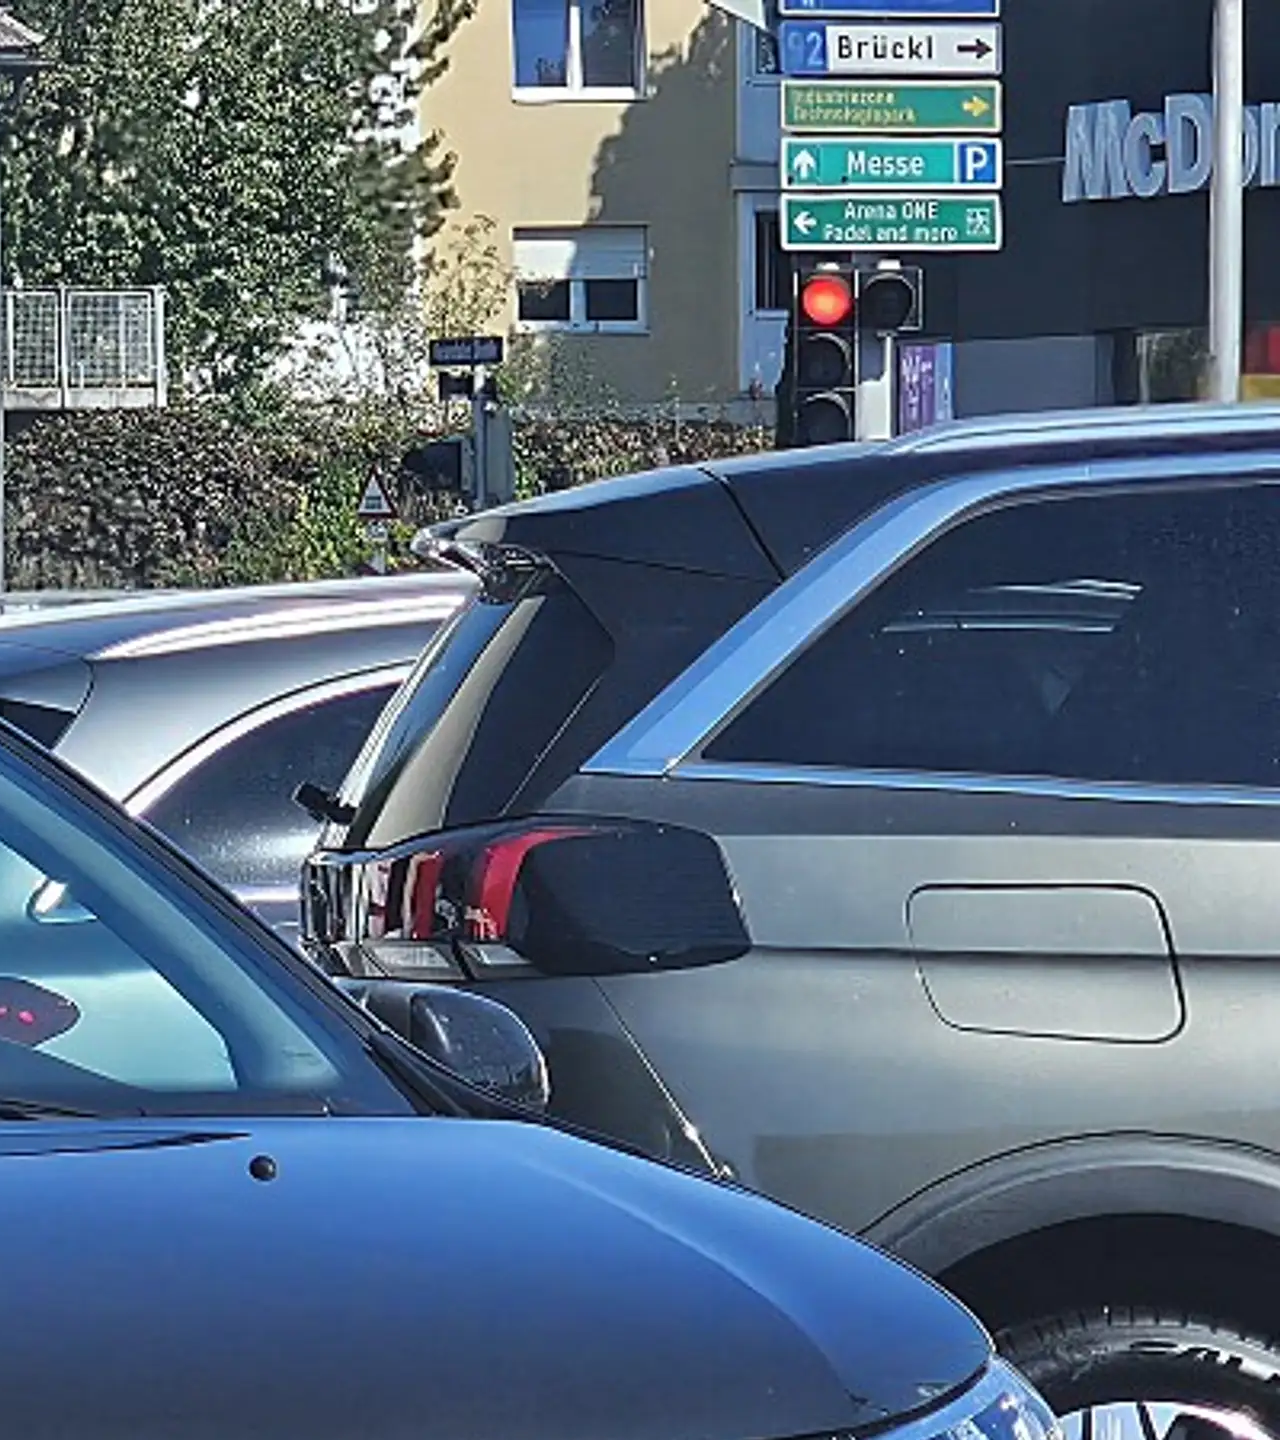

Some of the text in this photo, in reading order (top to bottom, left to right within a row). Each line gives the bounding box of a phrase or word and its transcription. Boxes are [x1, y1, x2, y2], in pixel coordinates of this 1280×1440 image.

[837, 34, 933, 60] Brückl
[847, 150, 926, 176] Messe
[844, 201, 939, 220] Arena ONE
[823, 225, 959, 242] Padel and more
